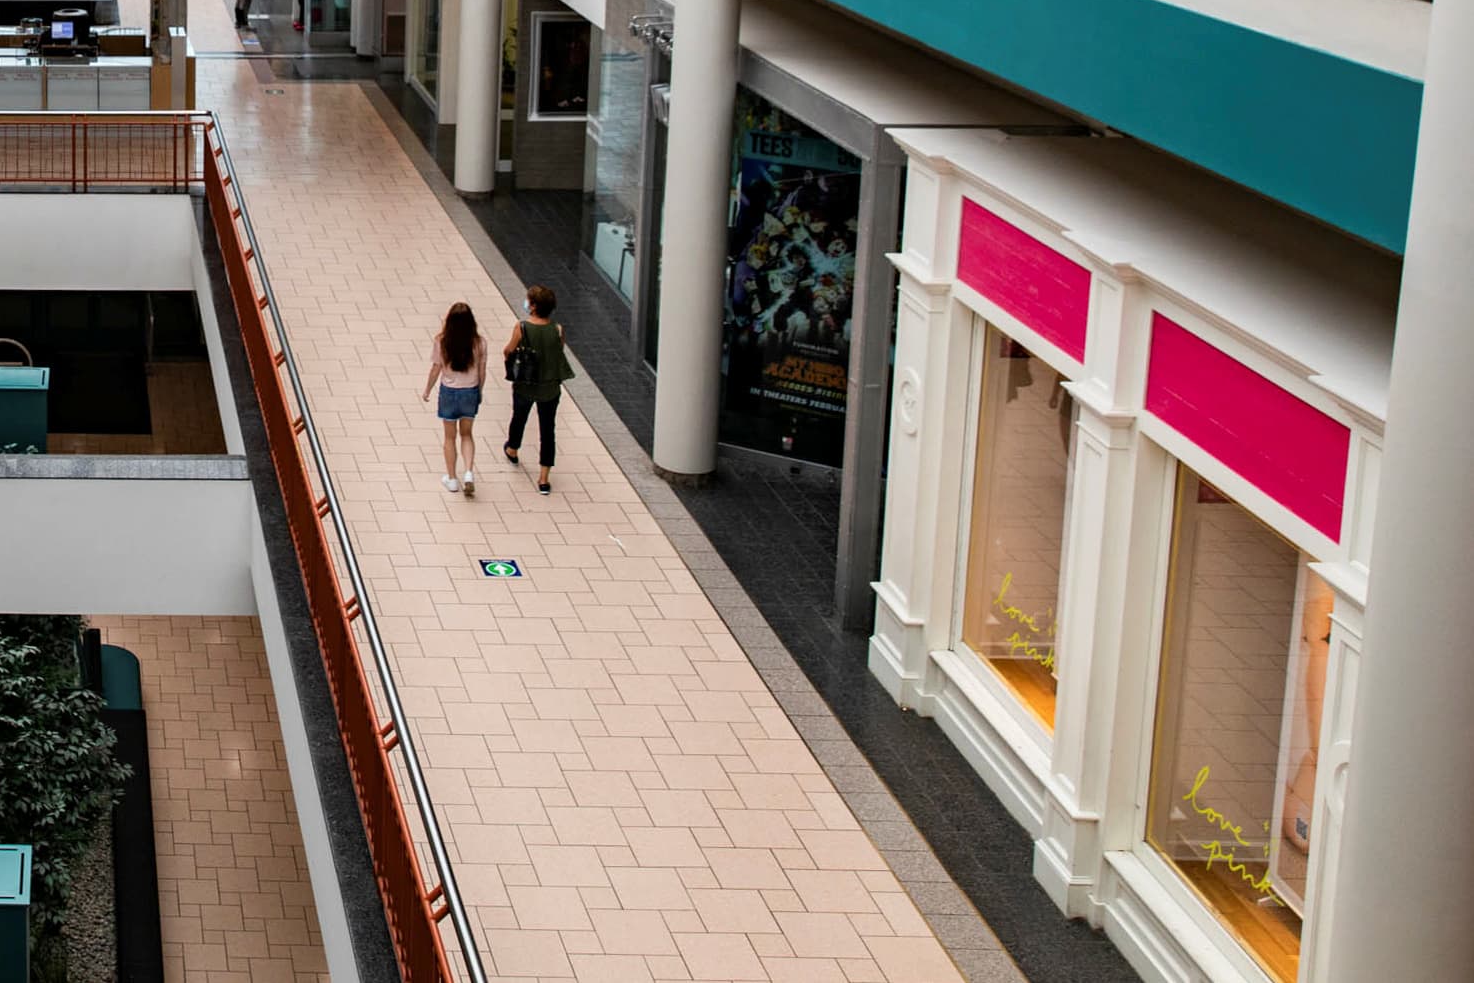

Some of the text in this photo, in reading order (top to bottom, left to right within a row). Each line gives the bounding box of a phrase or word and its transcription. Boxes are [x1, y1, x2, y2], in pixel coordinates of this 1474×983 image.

[749, 131, 794, 158] TEES
[749, 386, 761, 395] IN
[763, 389, 808, 405] THEATERS
[808, 399, 847, 414] FEBRUA
[1182, 766, 1251, 846] love
[1200, 840, 1285, 907] pink
